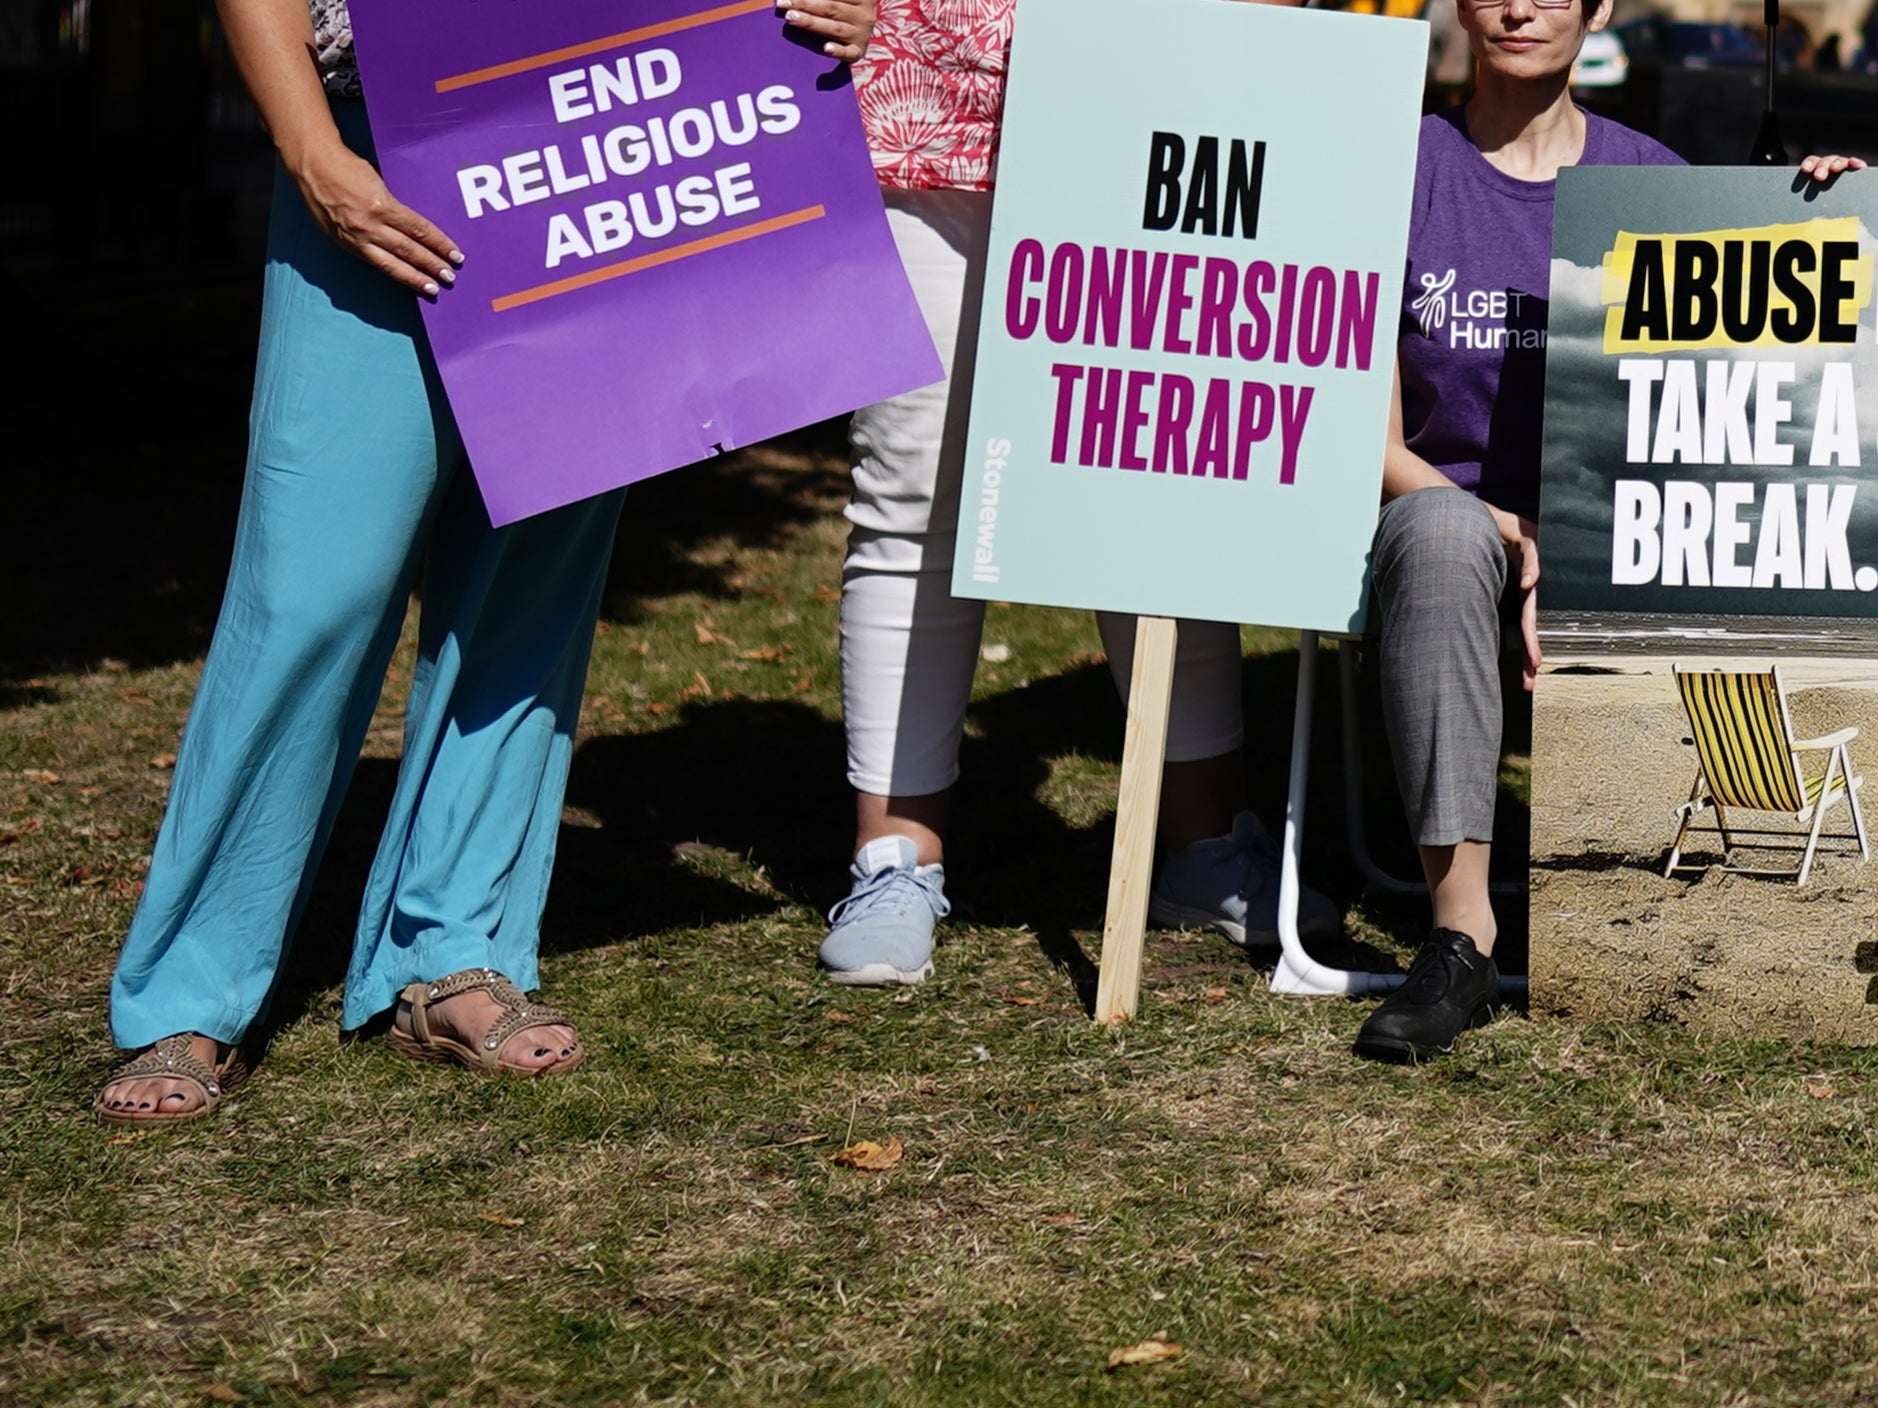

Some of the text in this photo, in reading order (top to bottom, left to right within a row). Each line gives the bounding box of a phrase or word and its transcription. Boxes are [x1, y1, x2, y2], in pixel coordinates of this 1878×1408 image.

[548, 47, 682, 123] END
[456, 85, 800, 219] RELIGIOUS
[1142, 131, 1266, 239] BAN
[545, 162, 761, 268] ABUSE
[1005, 239, 1380, 370] CONVERSION
[1451, 291, 1528, 318] LGBT
[1620, 239, 1859, 344] ABUSE
[1051, 363, 1315, 485] THERAPY
[1618, 359, 1794, 466] TAKE
[1808, 362, 1860, 467] A
[972, 437, 1012, 583] Stonewall
[1611, 479, 1878, 592] BREAK.
